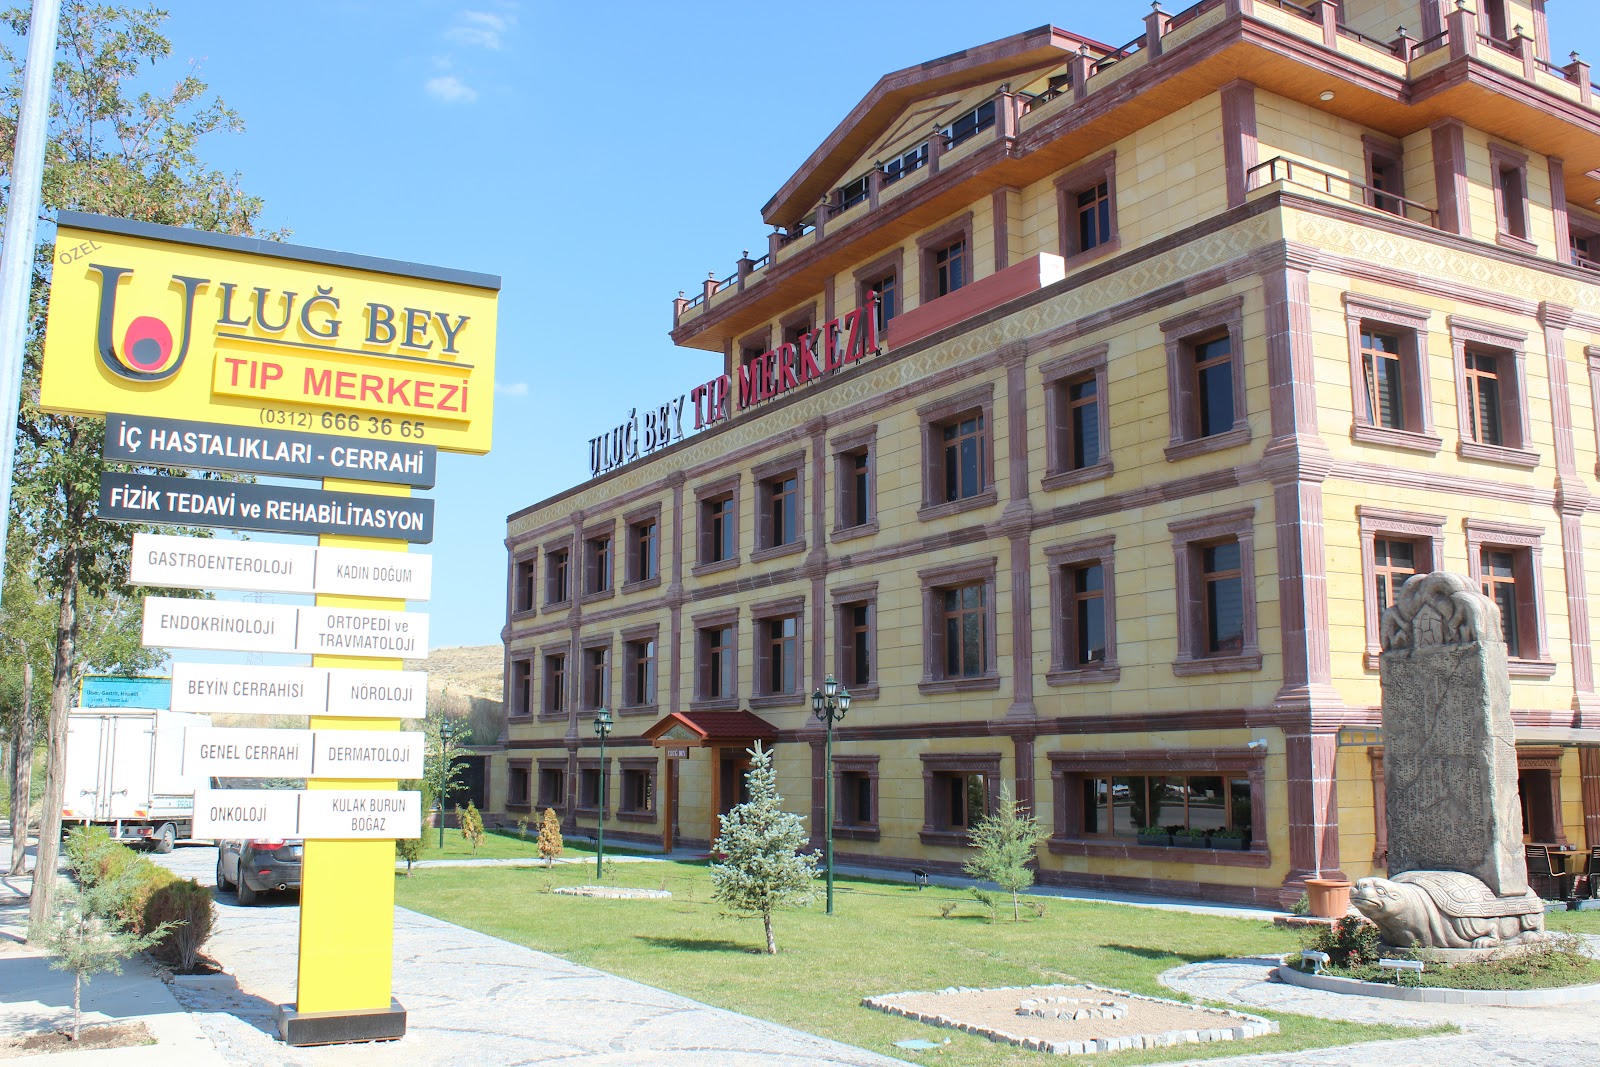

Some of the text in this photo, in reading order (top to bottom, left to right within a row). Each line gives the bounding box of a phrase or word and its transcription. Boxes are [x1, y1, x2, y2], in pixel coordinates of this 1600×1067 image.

[59, 238, 102, 266] ÖZEL
[365, 302, 471, 354] BEY
[224, 357, 469, 413] TIP MERKEZİ
[588, 289, 880, 475] ULUĞ BEY TIP MERKEZİ
[259, 407, 426, 440] (0312) 666 36 65
[119, 421, 142, 453] İÇ
[149, 428, 313, 465] HASTALIKLARI
[330, 445, 425, 475] CERRAHİ
[110, 483, 425, 532] FİZİK TEDAVİ ve REHABİLİTASYON
[148, 550, 293, 576] GASTROENTEROLOJİ
[336, 564, 413, 583] KADIN DOĞUM
[160, 613, 275, 635] ENDOKRİNOLOJİ
[327, 614, 409, 633] ORTOPEDİ ve
[319, 633, 415, 652] TRAVMATOLOJİ
[188, 676, 304, 699] BEYİN CERRAHİSİ
[351, 683, 413, 702] NÖROLOJİ
[200, 743, 299, 761] GENEL CERRAHİ
[328, 745, 410, 763] DERMATOLOJİ
[210, 804, 267, 822] ONKOLOJİ
[332, 798, 406, 813] KULAK BURUN
[351, 814, 386, 832] BOĞAZ
